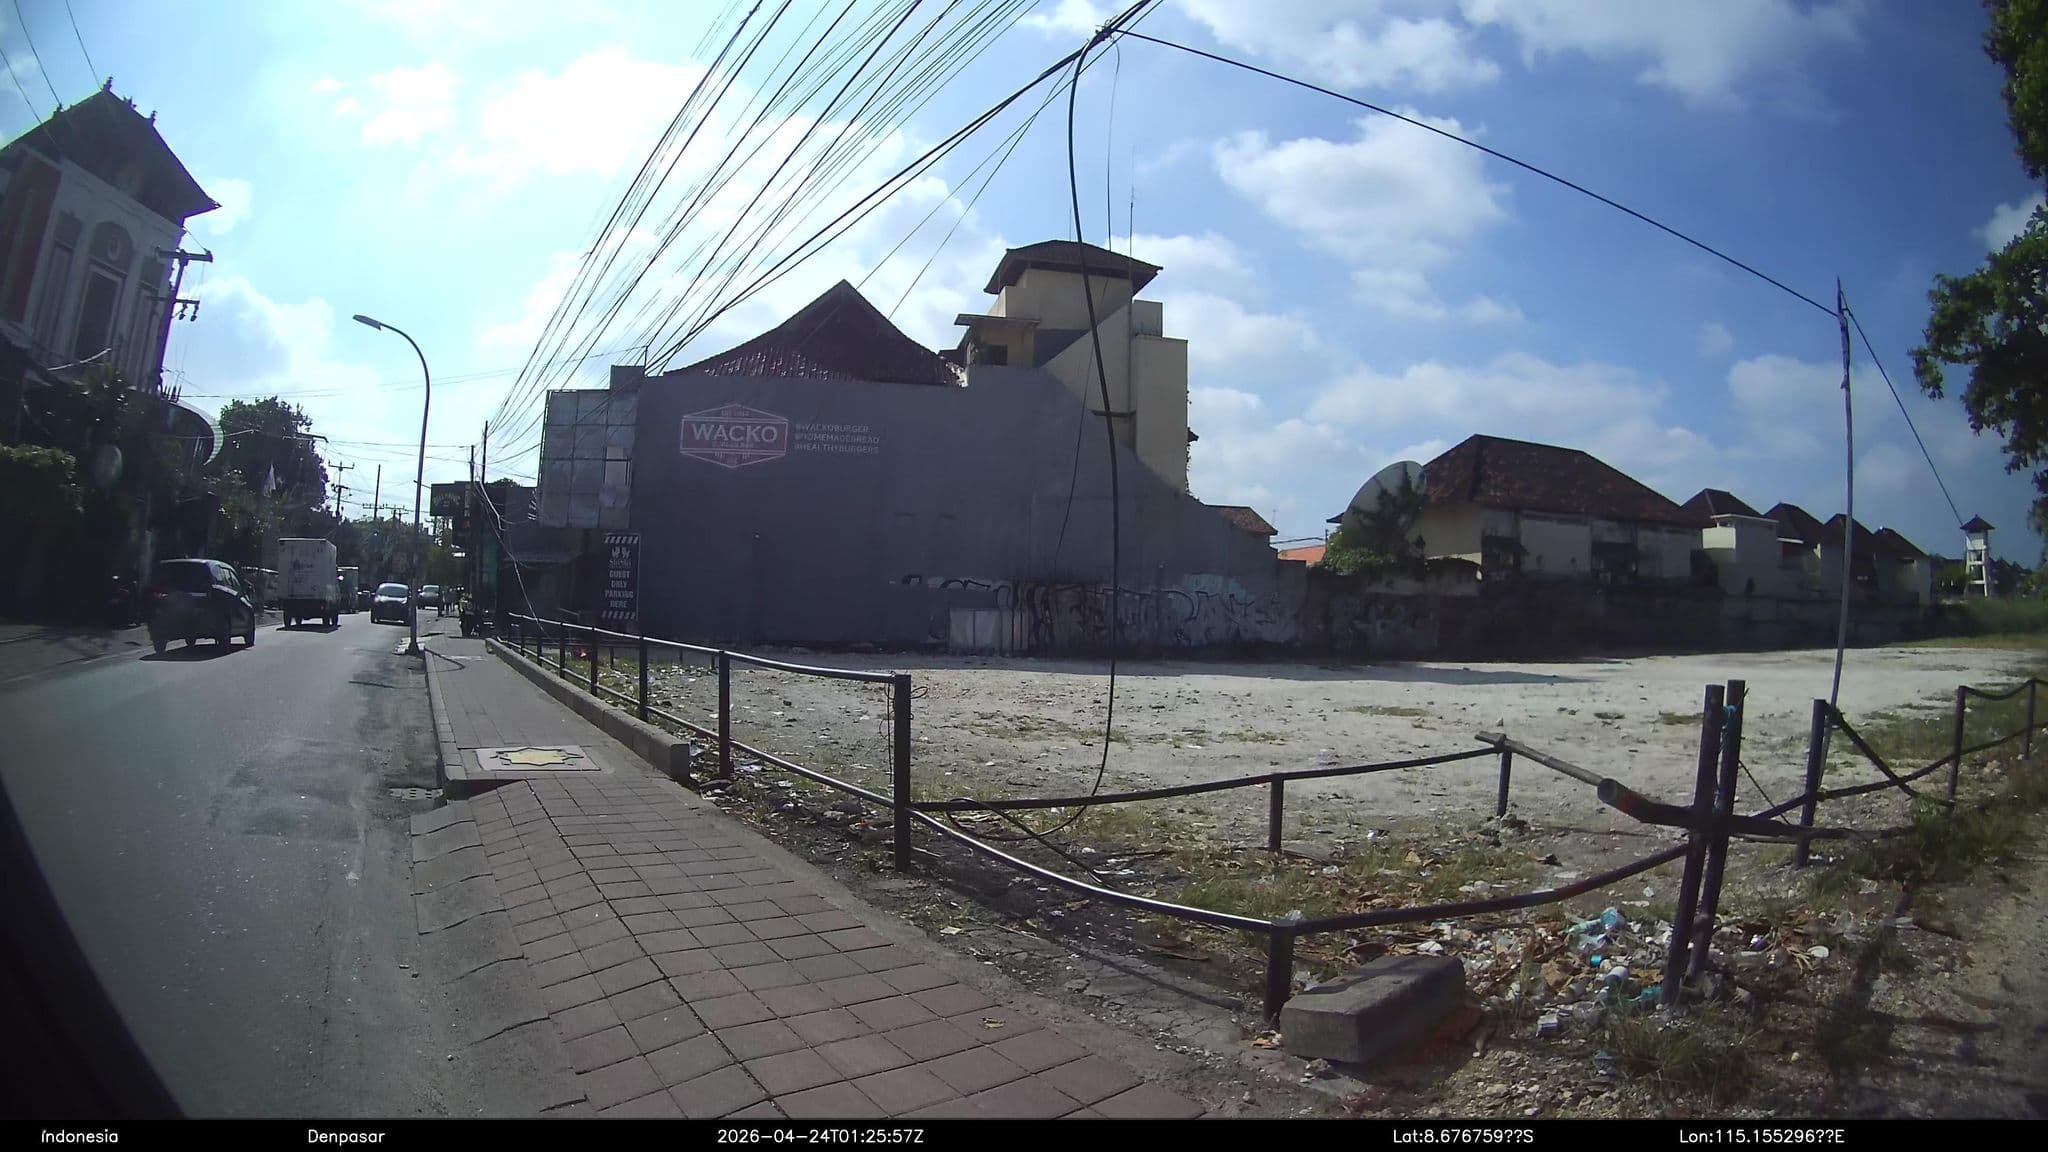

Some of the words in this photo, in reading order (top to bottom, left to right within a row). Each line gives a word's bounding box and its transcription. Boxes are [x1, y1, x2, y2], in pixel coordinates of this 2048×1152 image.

[692, 423, 778, 442] WACKO
[609, 570, 631, 578] GUEST
[604, 590, 634, 599] PARKING
